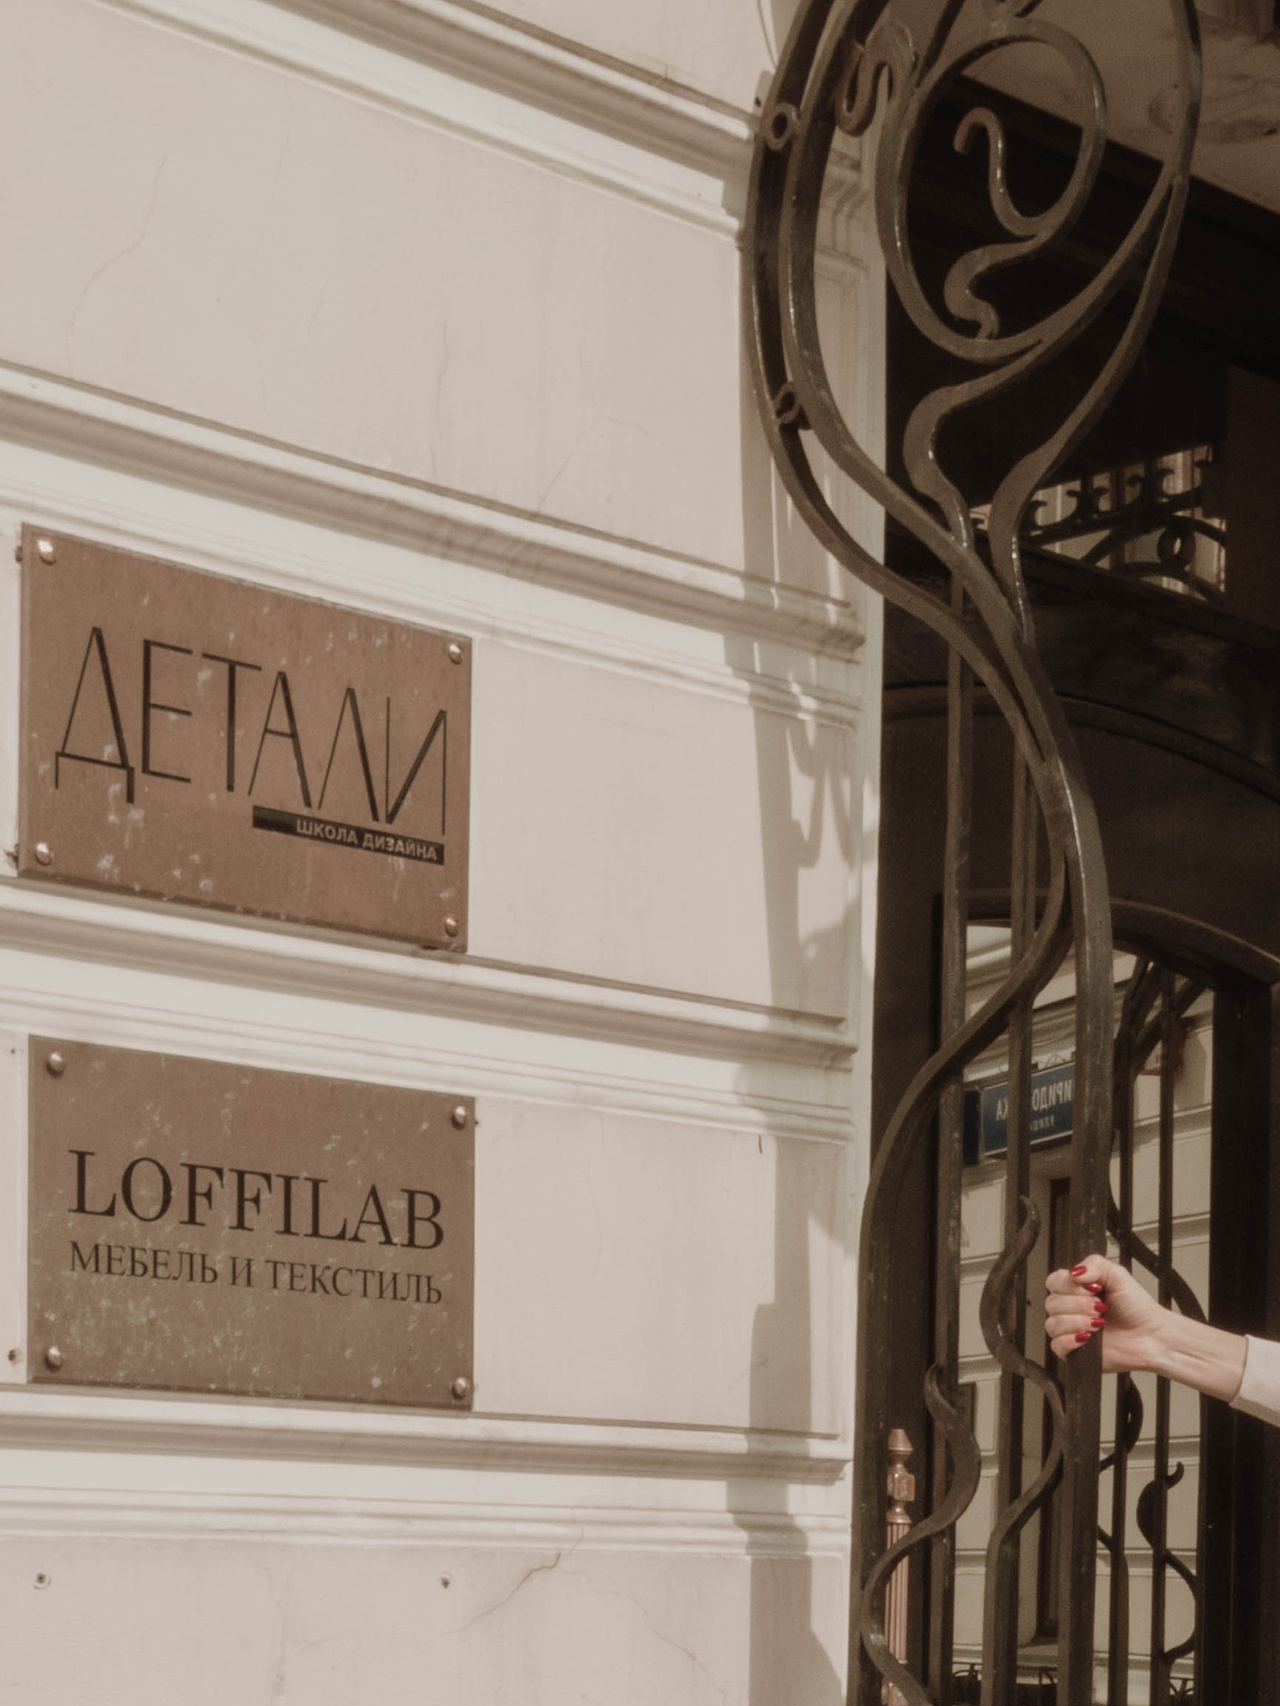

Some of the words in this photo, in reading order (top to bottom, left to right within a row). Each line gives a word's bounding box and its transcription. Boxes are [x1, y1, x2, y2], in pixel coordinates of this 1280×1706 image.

[55, 626, 447, 836] ДЕТАЛИ
[296, 819, 358, 845] ШКОЛА
[362, 832, 438, 861] ДИЗАЙНА
[68, 1149, 445, 1250] LOFFILAB
[70, 1240, 218, 1284] МЕБЕЛЬ
[229, 1256, 254, 1288] И
[265, 1258, 443, 1305] ТЕКСТИЛЬ
